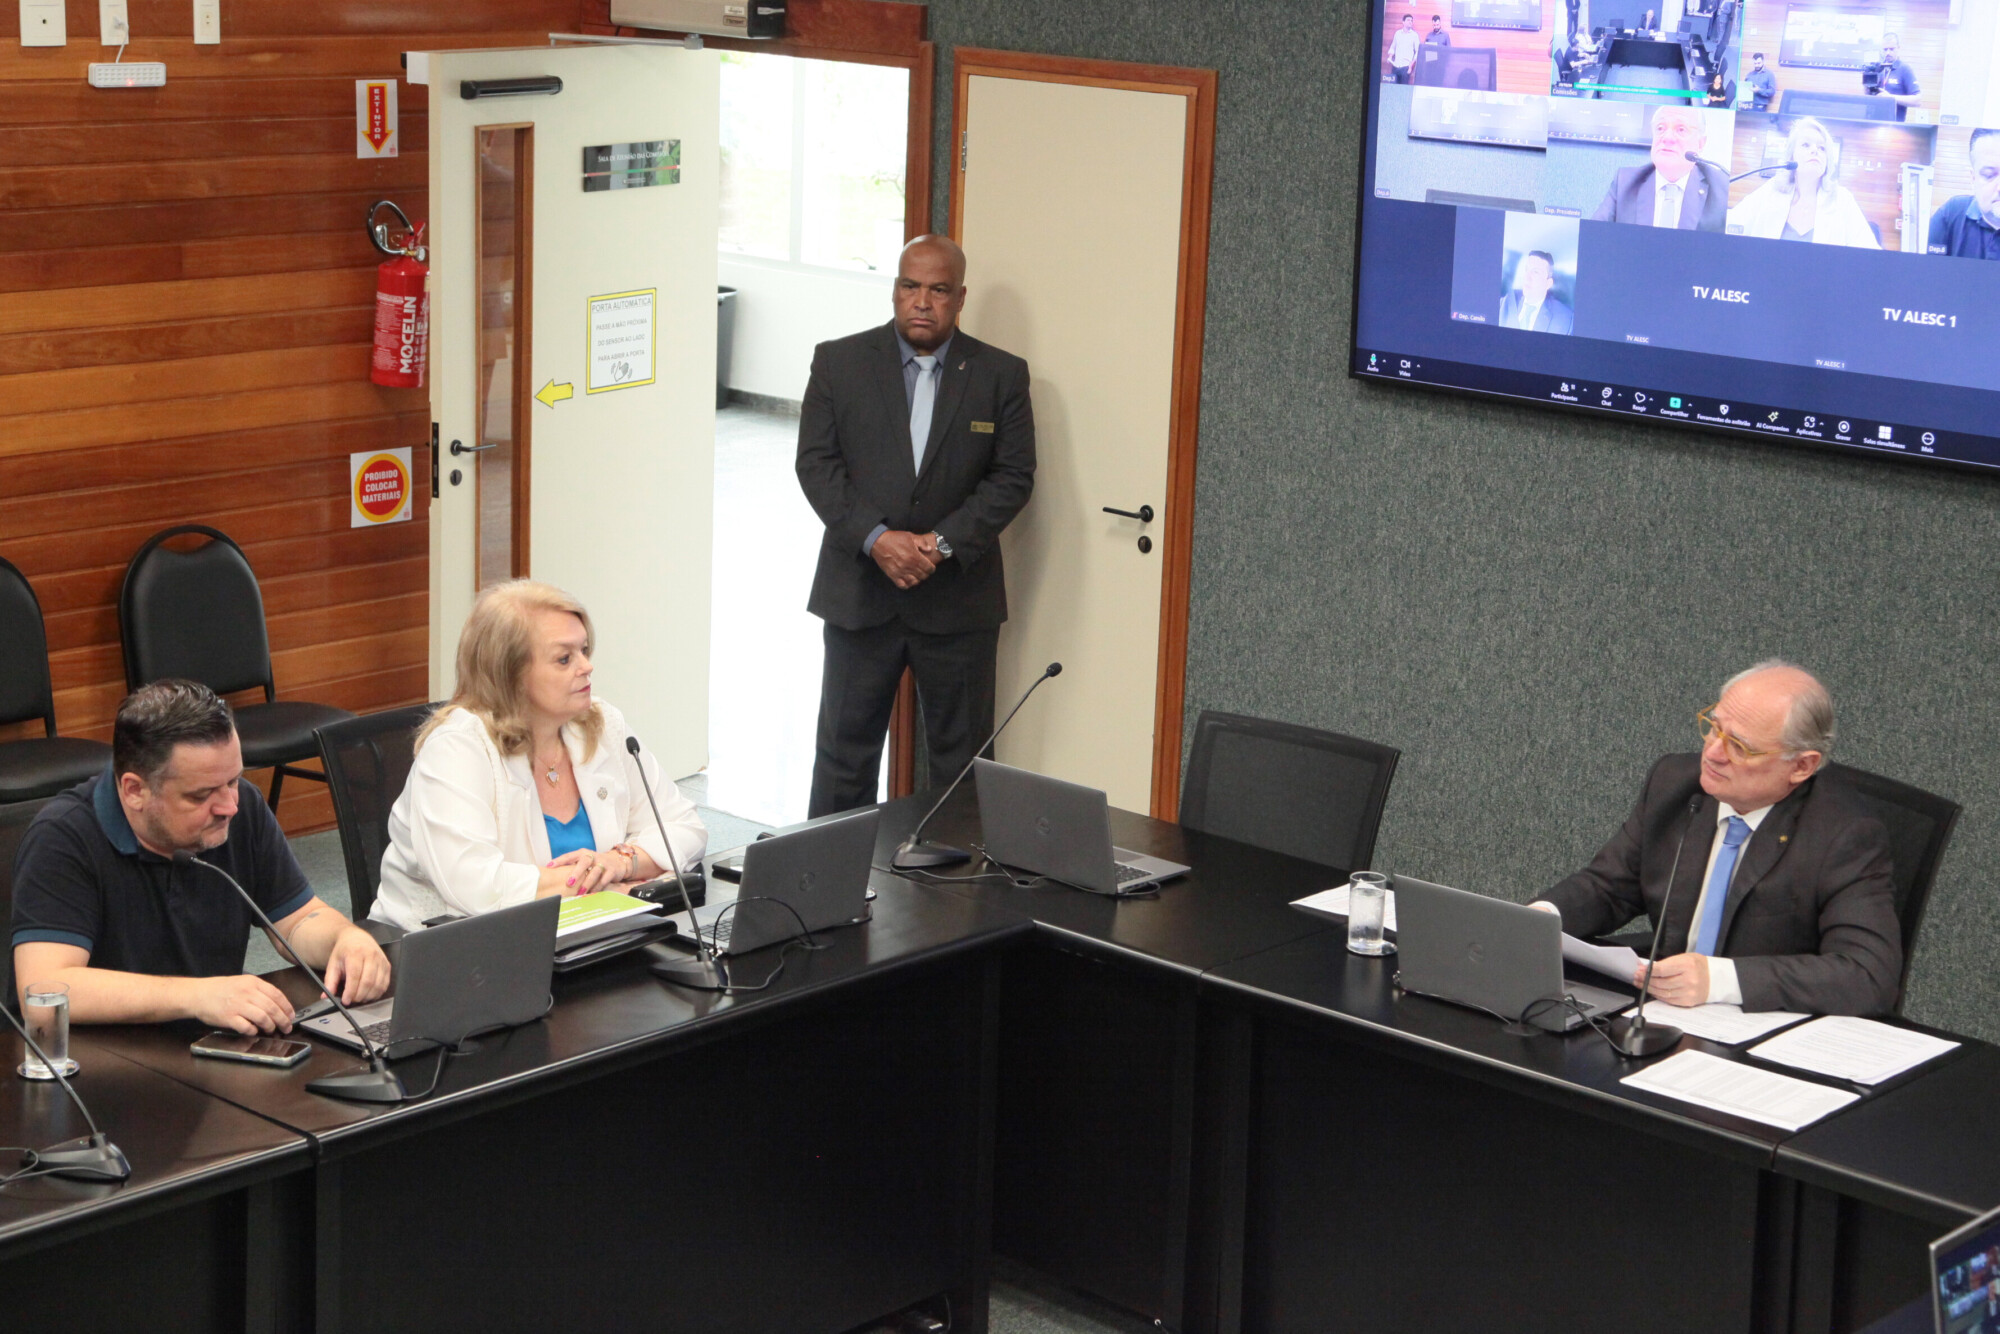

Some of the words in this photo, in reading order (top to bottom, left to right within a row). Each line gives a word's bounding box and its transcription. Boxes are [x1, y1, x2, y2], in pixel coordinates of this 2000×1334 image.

[1552, 88, 1578, 97] Comissões
[373, 87, 382, 140] EXTINTOR
[1692, 285, 1710, 299] TV
[1711, 288, 1750, 304] ALESC
[592, 302, 612, 312] PORTA
[613, 297, 652, 310] AUTOMÁTICA
[1882, 307, 1902, 321] TV
[1903, 310, 1946, 327] ALESC
[1949, 315, 1957, 328] 1
[596, 321, 611, 330] PASSE
[400, 296, 417, 374] MOCELIN
[1633, 335, 1649, 343] ALESC
[606, 336, 625, 345] SENSOR
[598, 354, 610, 362] PARA
[611, 351, 625, 360] ABRIR
[630, 349, 645, 357] PORTA
[1823, 360, 1841, 368] ALESC
[1550, 391, 1578, 402] Participantes
[1601, 399, 1612, 407] Chat
[1660, 407, 1690, 418] Compartilhar
[1762, 422, 1790, 432] Companion
[1796, 427, 1822, 437] Aplicativos
[1835, 433, 1851, 441] Gravar
[1863, 437, 1876, 445] Salas
[1921, 445, 1934, 454] Mais
[364, 469, 399, 482] PROIBIDO
[365, 480, 398, 493] COLOCAR
[362, 490, 401, 504] MATERIAIS
